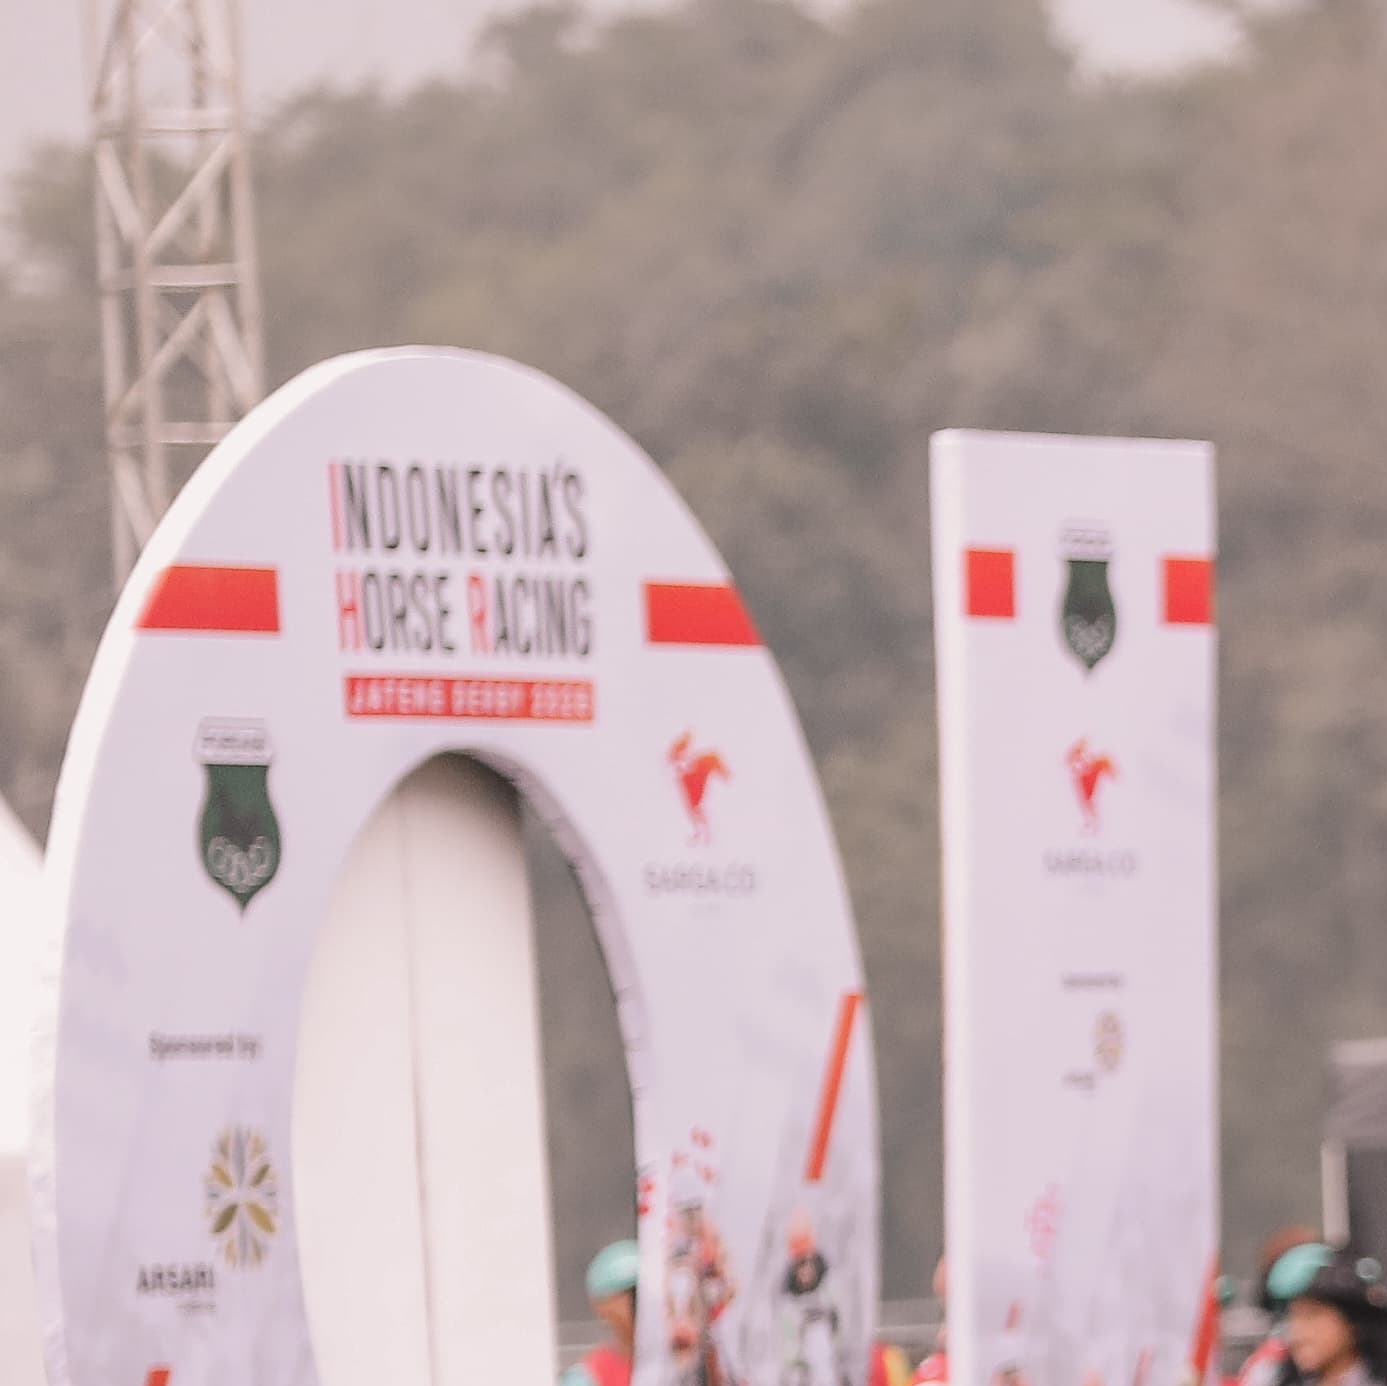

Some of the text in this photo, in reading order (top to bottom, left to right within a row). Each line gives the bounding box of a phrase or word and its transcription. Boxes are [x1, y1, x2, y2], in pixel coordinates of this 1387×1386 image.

[328, 458, 589, 558] INDONESIA'S
[336, 570, 592, 658] HORSE RACING
